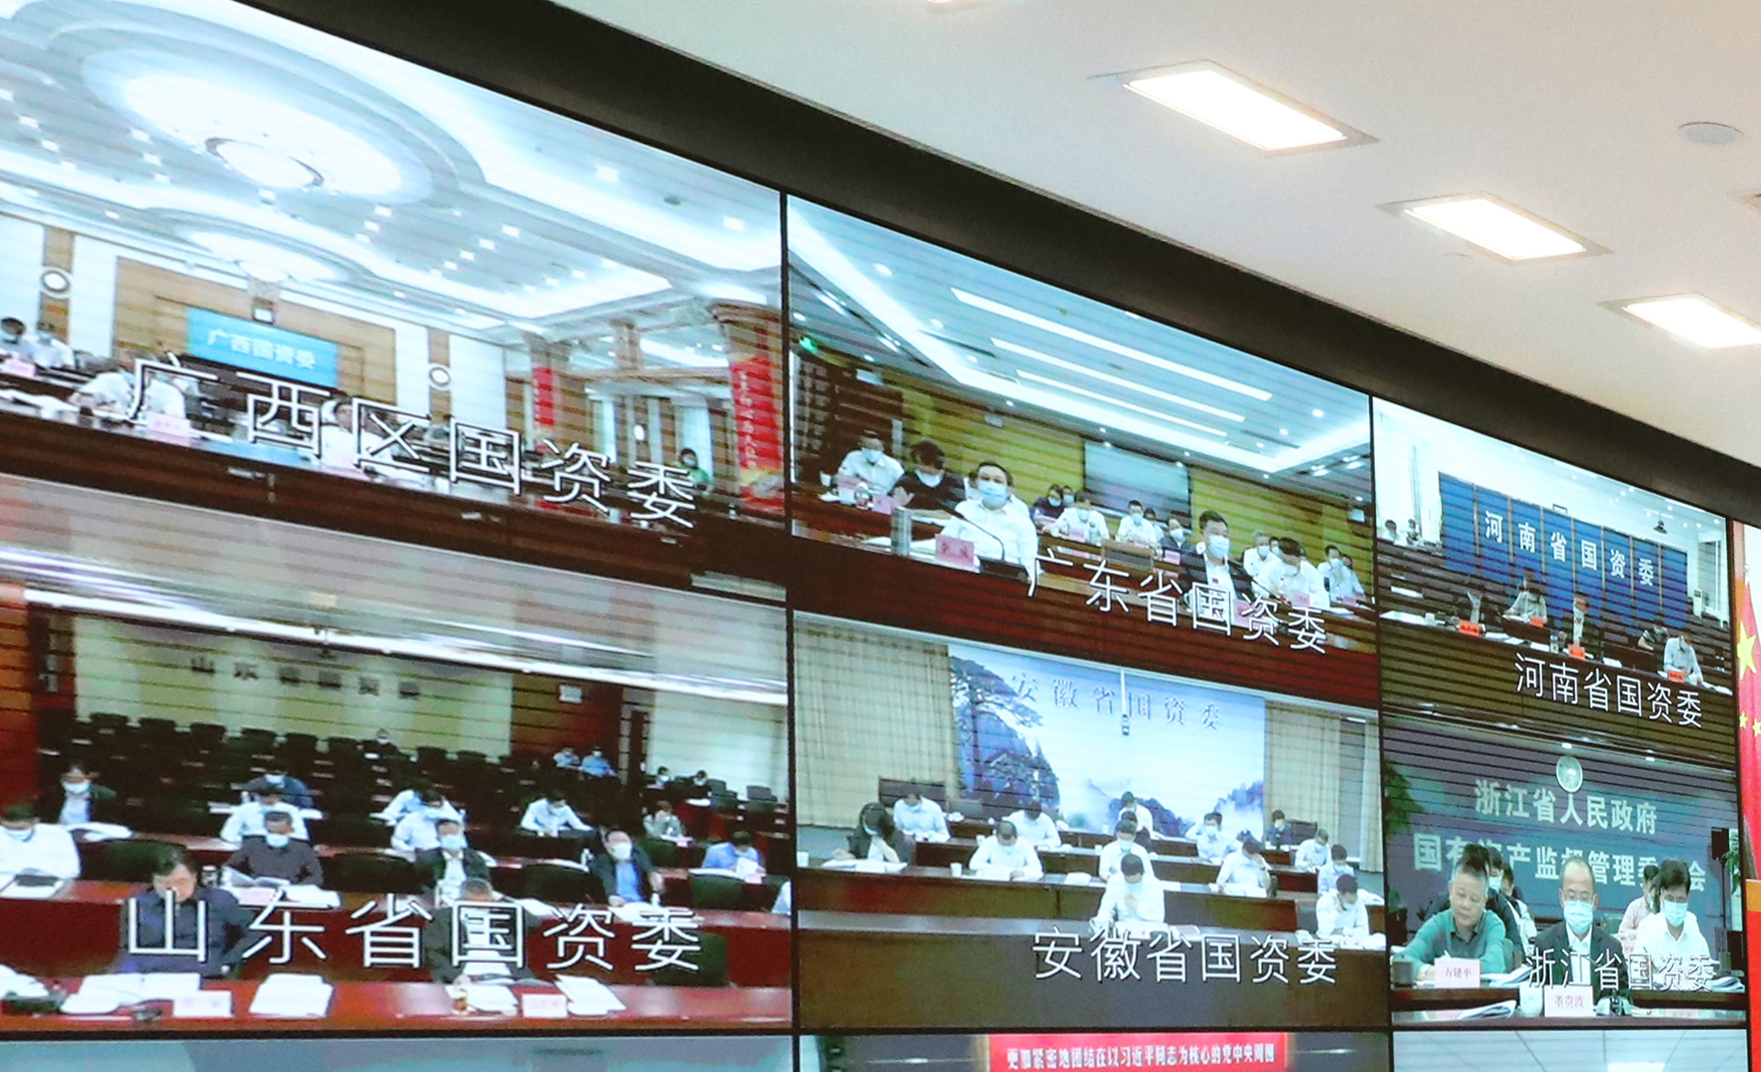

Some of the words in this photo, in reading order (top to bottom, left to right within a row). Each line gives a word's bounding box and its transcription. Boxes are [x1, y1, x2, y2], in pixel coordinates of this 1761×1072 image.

[128, 355, 697, 528] 广西区国资委
[1485, 510, 1654, 586] 河南省国资委
[1027, 548, 1327, 654] 广东省国资委
[1012, 672, 1220, 730] 安徽省国资委
[1514, 652, 1702, 728] 河南省国资委
[1474, 779, 1658, 835] 浙江省人民政府
[127, 890, 701, 971] 山东省国资委
[1032, 926, 1337, 984] 安徽省国资委
[1526, 946, 1717, 992] 浙江省国资委
[1006, 1043, 1276, 1071] 更加紧密地团结在以习近平同志为核心的党中央周围
